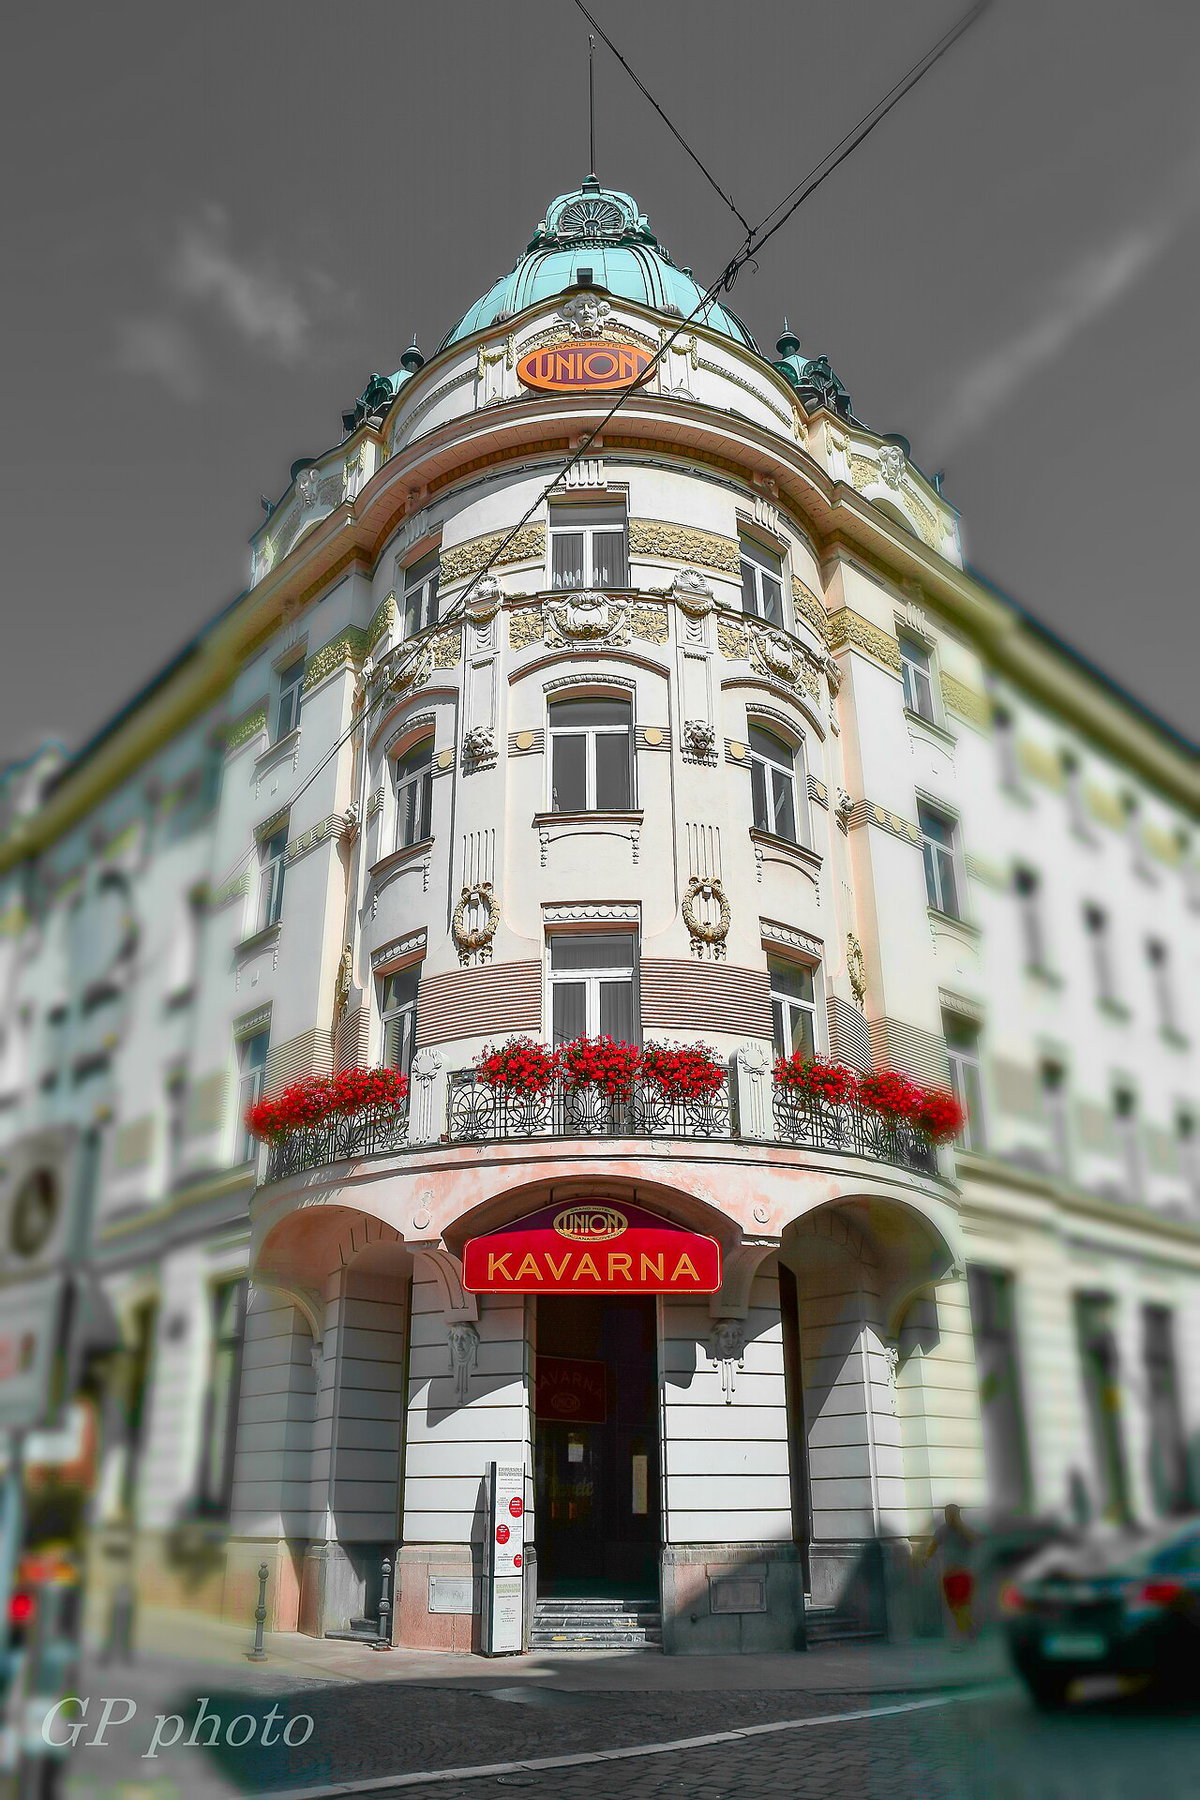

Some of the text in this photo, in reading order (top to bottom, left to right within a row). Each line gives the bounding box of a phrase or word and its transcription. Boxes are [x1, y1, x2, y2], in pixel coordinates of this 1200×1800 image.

[547, 342, 625, 352] GRAND HOTEL
[535, 351, 638, 381] UNION
[563, 1214, 619, 1234] UNION
[487, 1252, 701, 1281] KAVARNA
[536, 1368, 602, 1400] AVARNA
